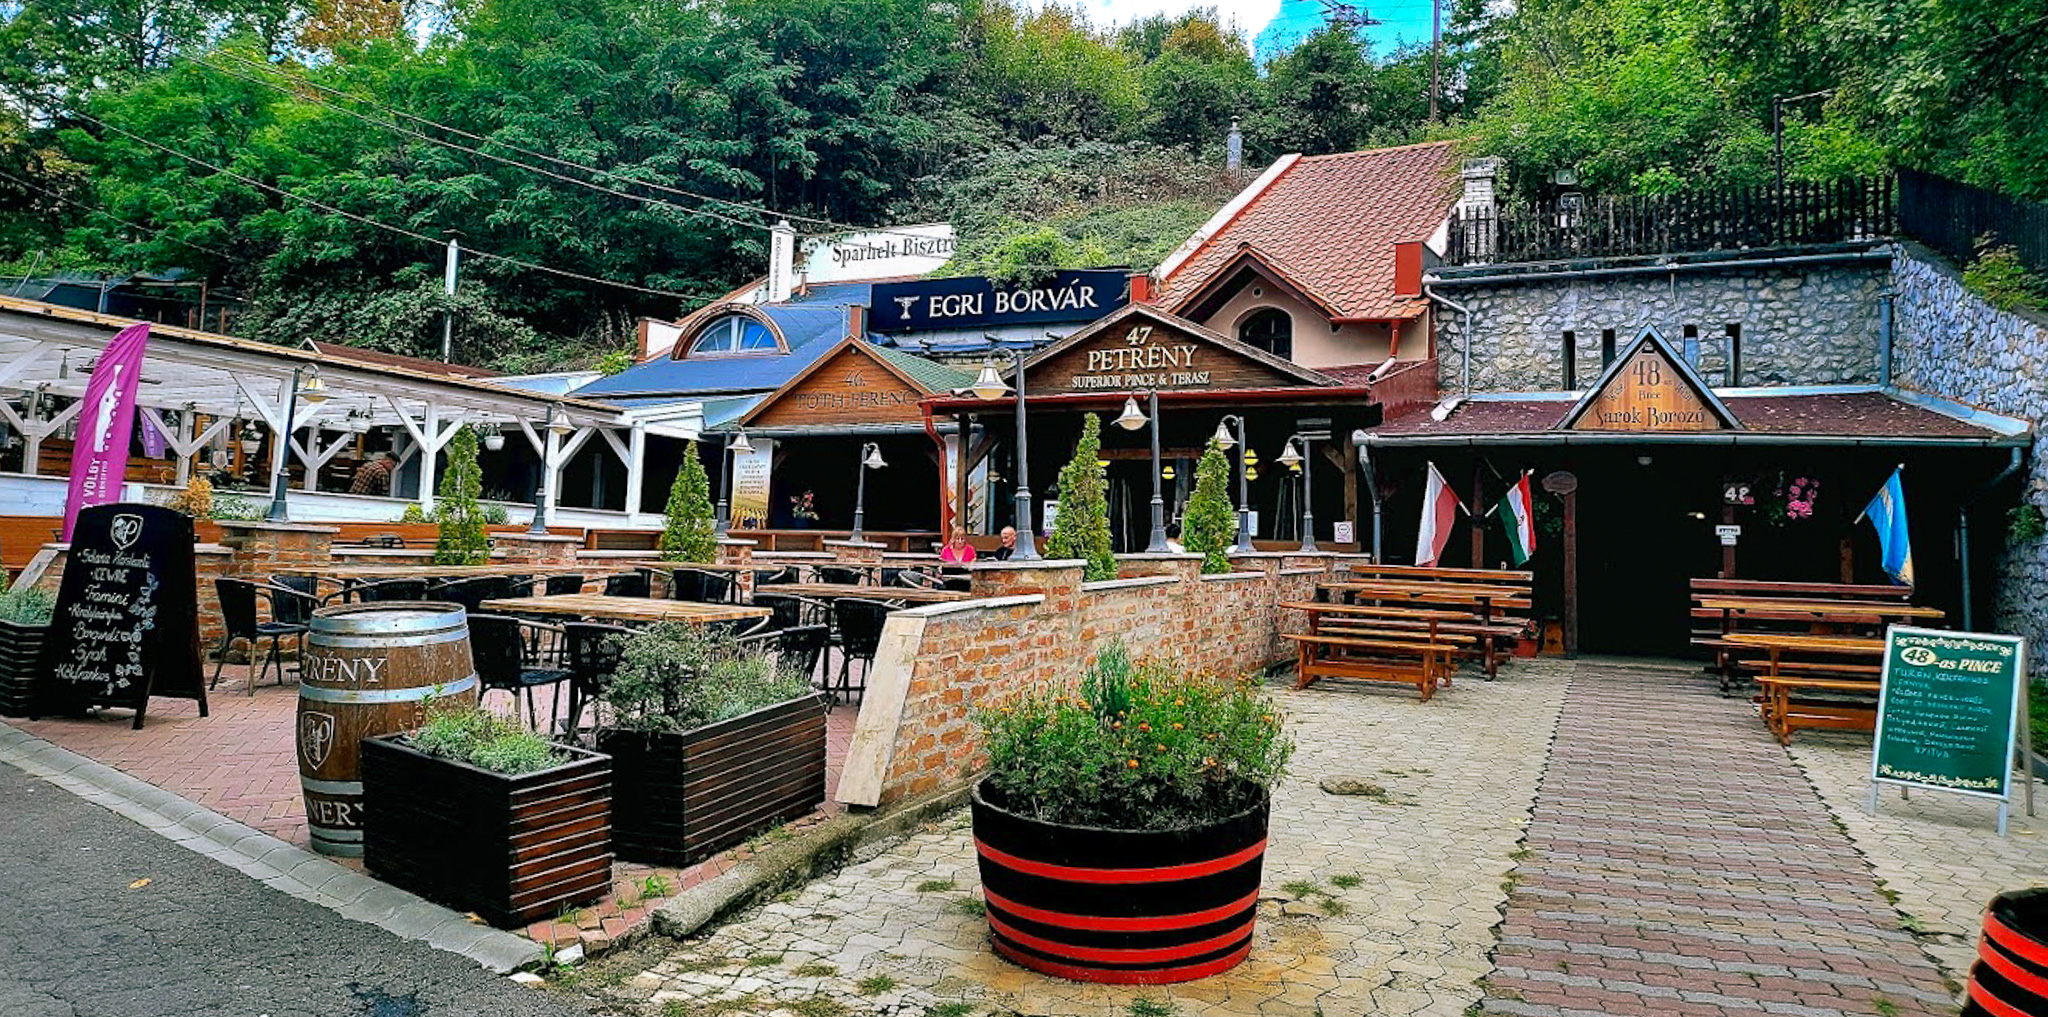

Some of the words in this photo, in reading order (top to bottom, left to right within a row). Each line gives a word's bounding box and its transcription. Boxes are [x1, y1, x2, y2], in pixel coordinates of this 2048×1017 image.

[832, 239, 897, 268] Sparhelt
[928, 292, 983, 318] EGRI
[994, 278, 1099, 314] BORVÁR
[1125, 326, 1153, 346] 47
[1087, 342, 1198, 371] PETRÉNY
[1072, 375, 1121, 388] SUPERIOR
[1124, 374, 1156, 387] PINCE
[1158, 375, 1168, 386] &
[1171, 371, 1211, 385] TERASZ
[850, 390, 915, 408] FERENC
[1958, 658, 2003, 674] PINCE
